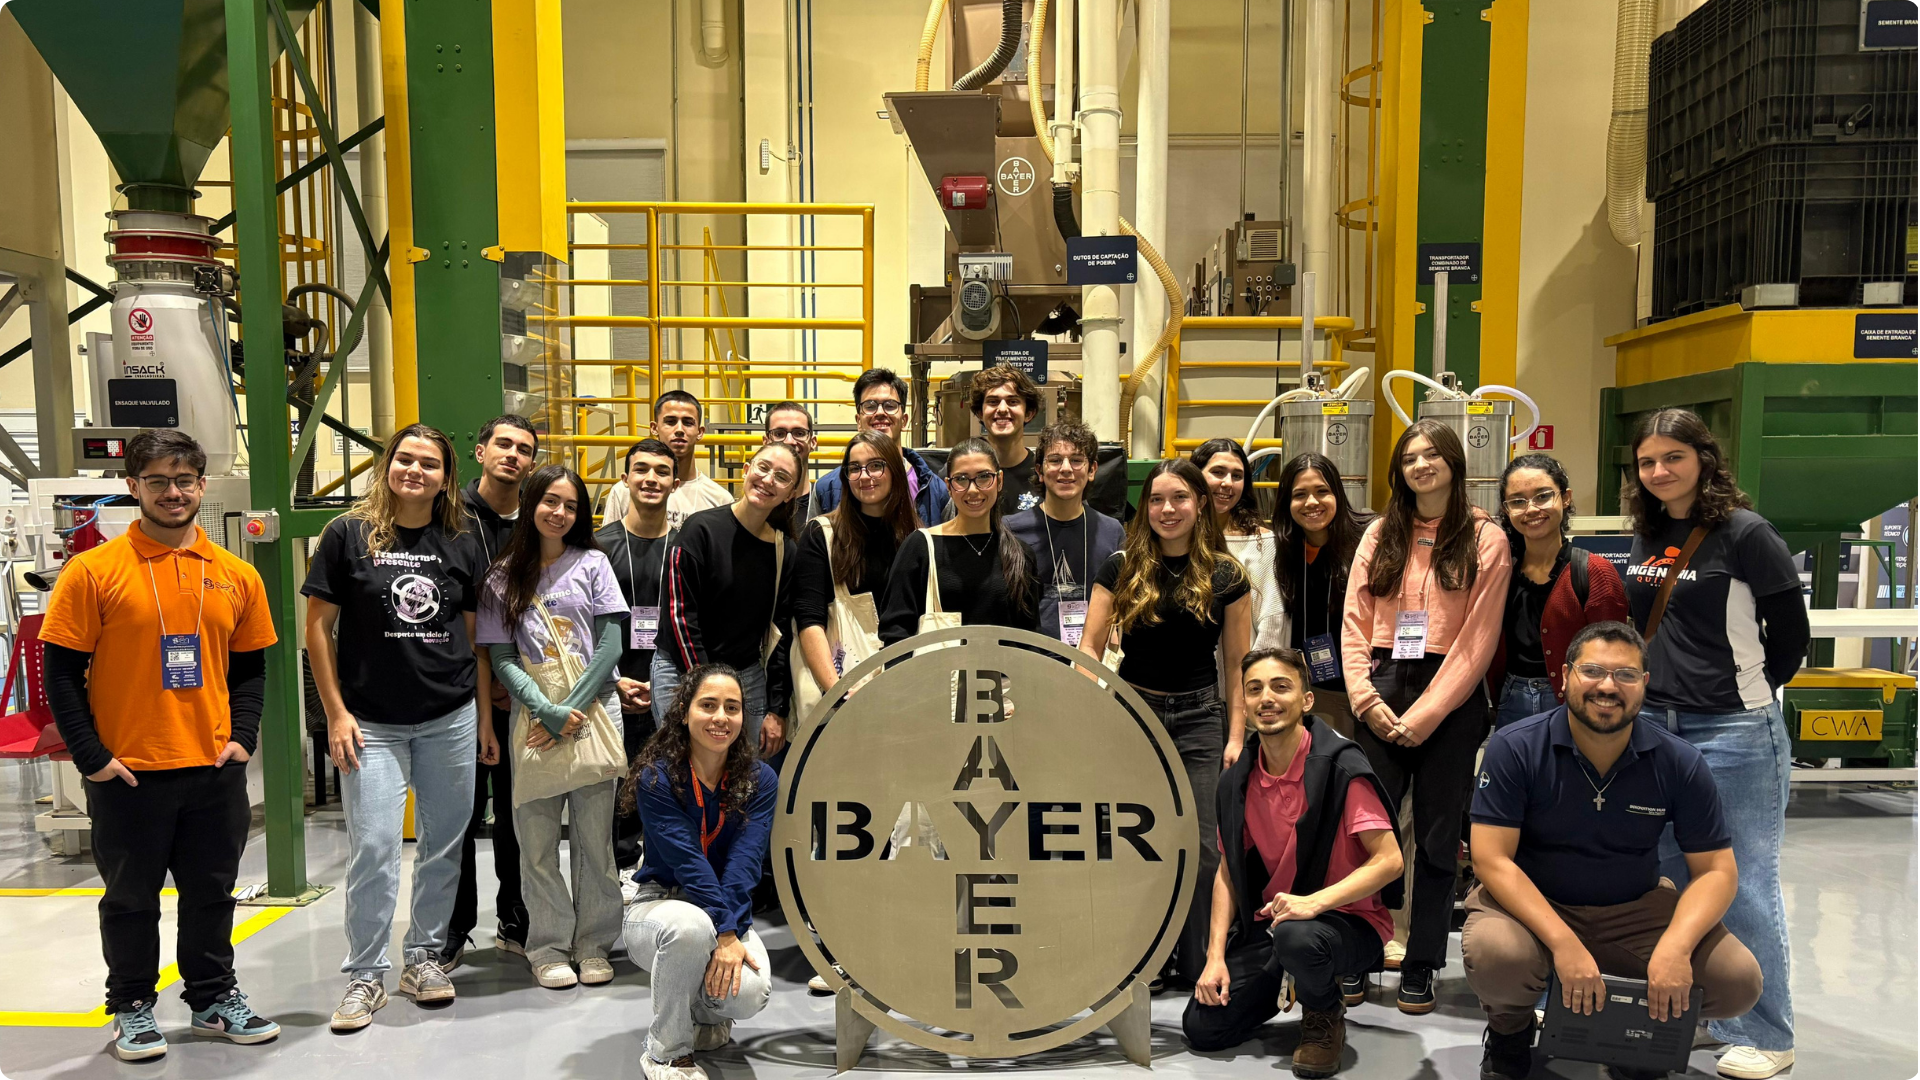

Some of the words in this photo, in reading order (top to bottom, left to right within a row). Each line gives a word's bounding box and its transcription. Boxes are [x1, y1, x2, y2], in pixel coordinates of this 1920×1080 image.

[374, 550, 436, 562] Transforme
[374, 558, 420, 568] presente
[1626, 565, 1696, 581] ENGENRIA
[1812, 716, 1871, 736] CWA
[810, 801, 1163, 861] BAYER
[950, 670, 1024, 1008] BAYER
